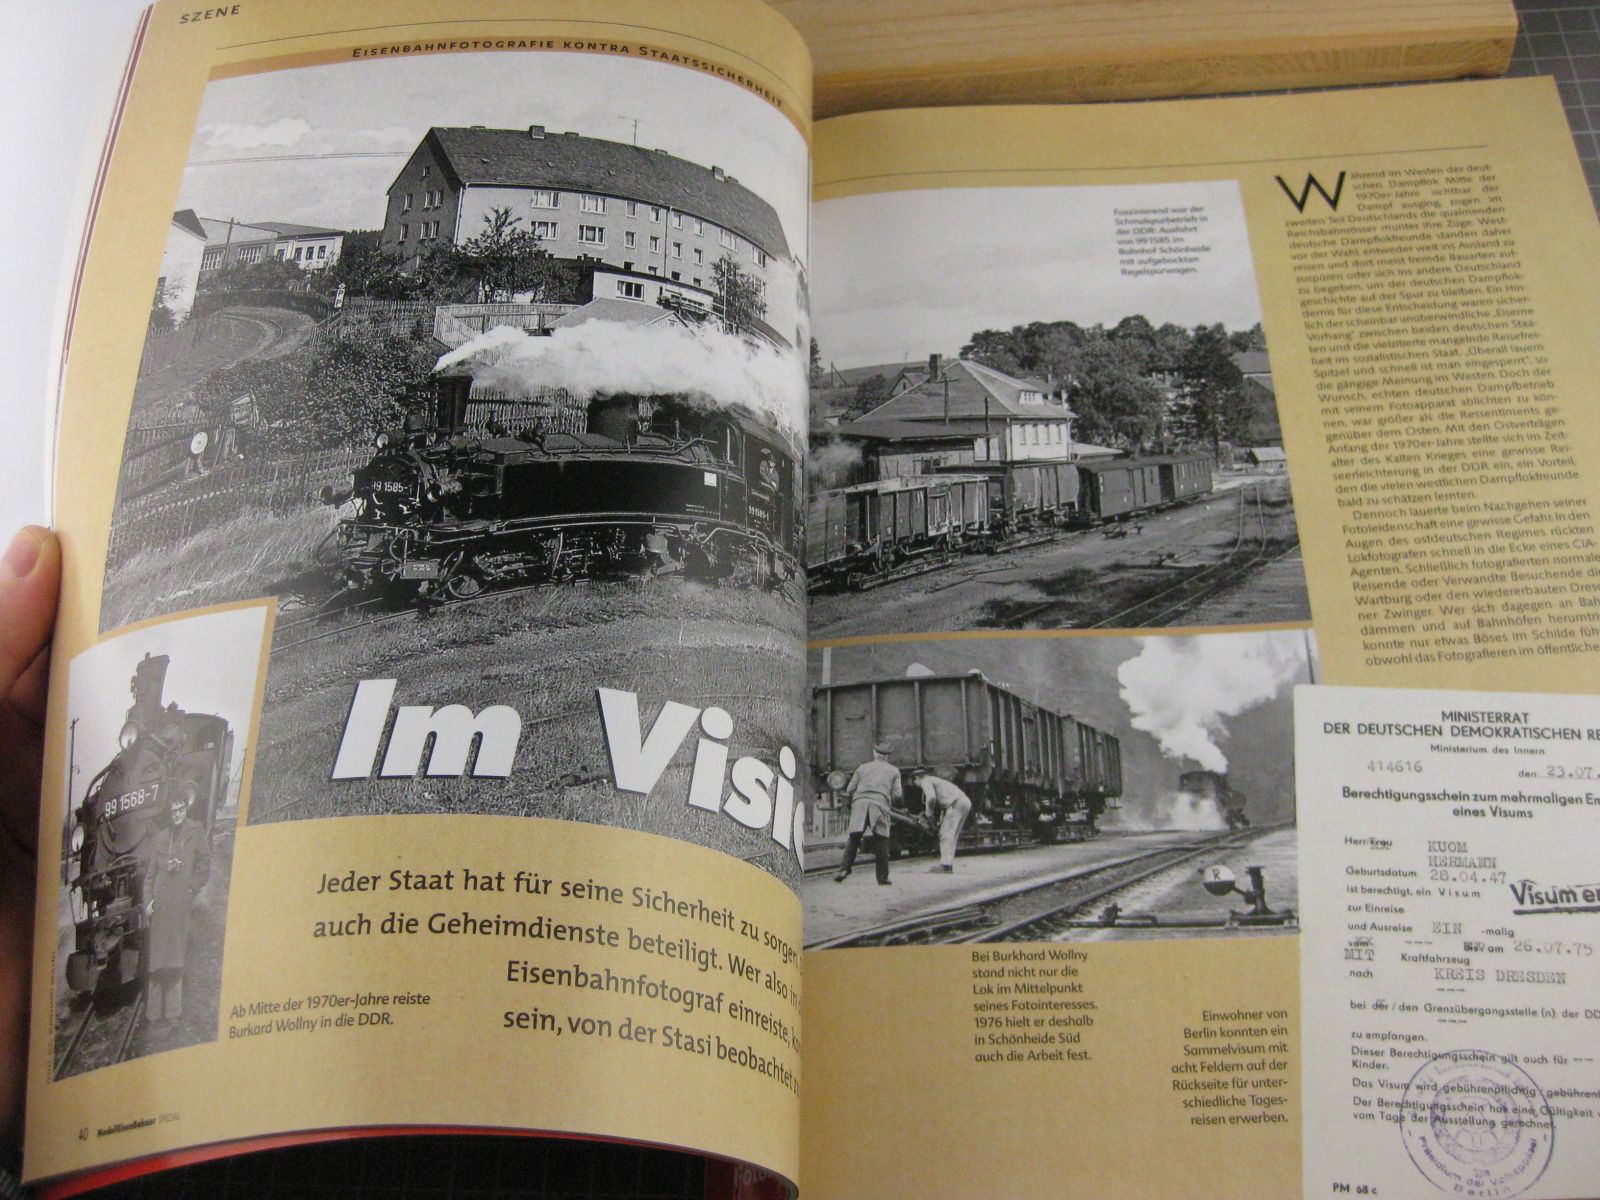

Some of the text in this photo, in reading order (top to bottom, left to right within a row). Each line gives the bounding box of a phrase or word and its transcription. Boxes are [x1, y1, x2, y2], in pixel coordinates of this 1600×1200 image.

[180, 4, 241, 24] SZENE
[563, 41, 630, 54] KONTRA
[1353, 499, 1587, 520] Dennoch lauerte beim Nachgehen seiner
[1345, 525, 1594, 550] Augen Regimes rückten
[1347, 548, 1426, 563] Lokfotografen
[1508, 542, 1536, 553] Ecke
[1437, 648, 1517, 664] Fotografieren
[1441, 710, 1529, 724] MINISTERRAT
[1323, 722, 1351, 734] DER
[1357, 722, 1443, 737] DEUTSCHEN
[1450, 725, 1581, 740] DEMOKRATISCHEN
[1430, 744, 1545, 755] Ministerium des Innern
[1367, 760, 1423, 773] 414616
[331, 679, 804, 873] Im Visi
[105, 783, 160, 817] 99 1568-7
[1342, 785, 1583, 806] Berechtigungsschein zum mehrmaligen
[1452, 806, 1534, 819] eines Visums
[1345, 866, 1417, 878] Geburtsdatum
[1346, 885, 1431, 897] ist berechtigt, ein
[1509, 881, 1577, 905] Visum
[317, 871, 381, 894] Jeder
[389, 869, 454, 891] Staat
[464, 869, 505, 892] hat
[514, 871, 552, 895] für
[561, 879, 623, 904] seine
[632, 886, 735, 931] Sicherheit
[740, 918, 759, 942] zu
[1365, 903, 1405, 914] Einreise
[1347, 921, 1413, 932] und Ausreise
[313, 913, 371, 937] auch
[380, 912, 419, 934] die
[428, 912, 619, 948] Geheimdienste
[628, 927, 723, 972] beteiligt.
[728, 953, 761, 983] Wer
[765, 970, 788, 999] also
[972, 950, 1088, 964] Bei Burkhard Wollny
[1401, 952, 1471, 966] Kraftfahrzeug
[972, 966, 1079, 978] stand nicht nur die
[1349, 967, 1373, 978] nach
[973, 982, 1083, 995] Lok im Mittelpunkt
[230, 992, 431, 1019] Ab Mitte der 1970er-Jahre reiste
[506, 960, 724, 1013] Eisenbahnfotograf
[728, 1001, 791, 1048] einreiste,
[973, 999, 1098, 1012] seines Fotointeresses.
[1350, 1000, 1538, 1018] bei Grenzübergangsstelle
[975, 1015, 1094, 1028] 1976 hielt er deshalb
[1202, 1009, 1288, 1021] Einwohner von
[229, 1012, 394, 1039] Burkard Wollny in die DDR.
[1183, 1025, 1288, 1039] Berlin konnten ein
[974, 1031, 1081, 1045] in Schönheide Süd
[1352, 1030, 1428, 1043] zu empfangen.
[503, 1007, 562, 1036] sein,
[568, 1015, 612, 1038] von
[618, 1016, 657, 1044] der
[662, 1025, 712, 1056] Stasi
[716, 1036, 792, 1091] beobachtet
[975, 1049, 1092, 1062] auch die Arbeit fest.
[1183, 1041, 1288, 1056] Sammelvisum mit
[1351, 1046, 1568, 1064] Dieser Berechtigungsschein auch für
[1171, 1058, 1288, 1074] acht Feldern auf der
[1352, 1060, 1389, 1071] Kinder.
[1172, 1077, 1288, 1091] Rückseite für unter-
[1352, 1077, 1373, 1088] Das
[1378, 1079, 1410, 1091] Visum
[1182, 1094, 1288, 1108] schiedliche Tages-
[1353, 1096, 1372, 1107] Der
[1377, 1098, 1484, 1113] Berechtigungsschein
[1191, 1112, 1289, 1125] reisen erwerben.
[1333, 1182, 1350, 1194] PM
